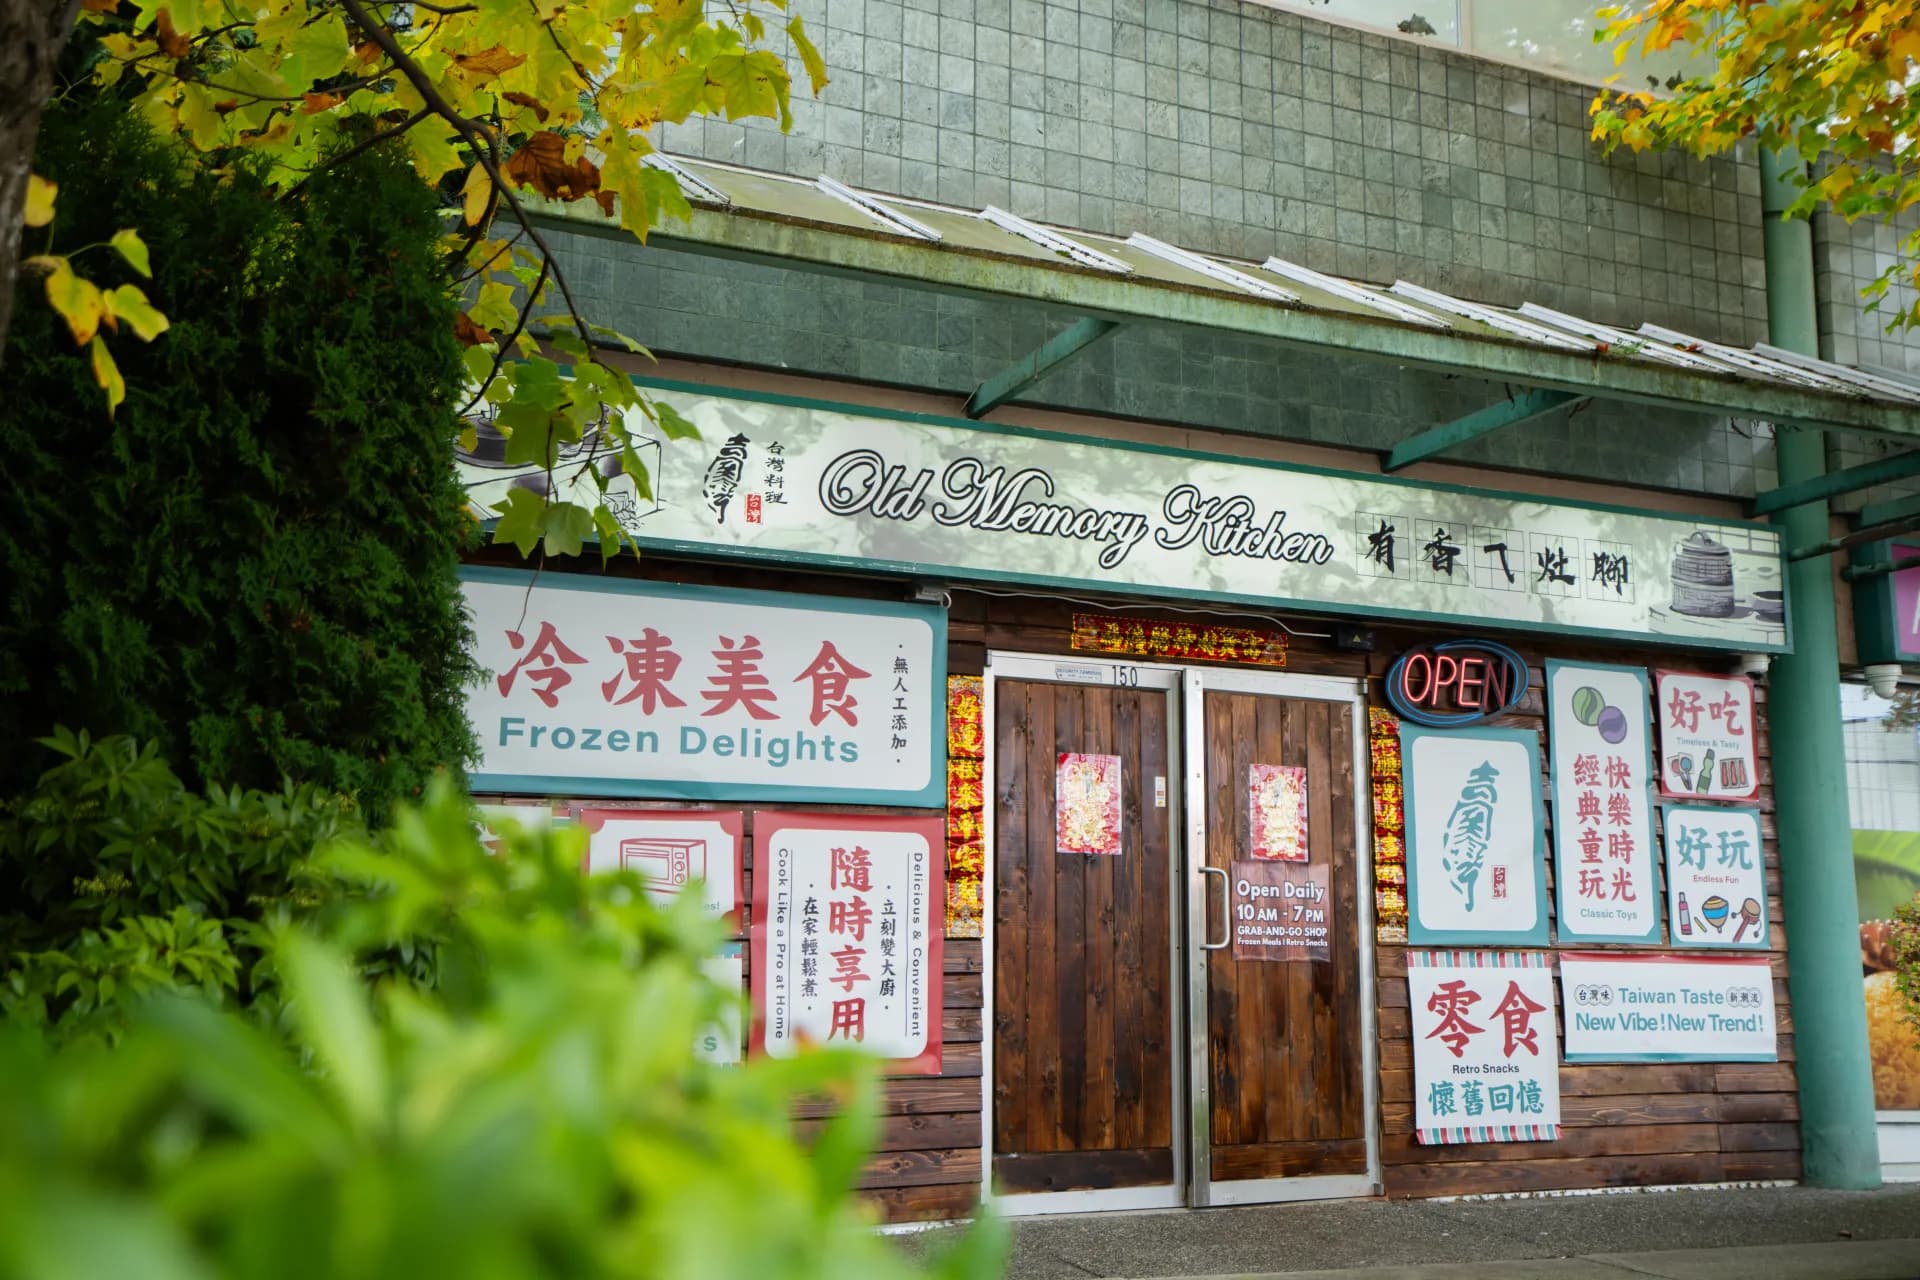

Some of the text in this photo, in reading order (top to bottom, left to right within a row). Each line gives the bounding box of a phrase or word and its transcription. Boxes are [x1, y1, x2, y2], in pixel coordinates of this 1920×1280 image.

[764, 441, 788, 504] 台灣料理
[819, 448, 1334, 569] Old Memory Kitchen
[497, 620, 872, 727] 冷凍美食
[1111, 665, 1138, 687] 150
[1404, 654, 1508, 708] OPEN
[890, 655, 909, 750] 無人工添加
[1668, 687, 1744, 736] 好吃
[500, 717, 859, 767] Frozen Delights
[1573, 754, 1606, 901] 經典童玩
[1605, 755, 1637, 902] 快樂時光
[1675, 824, 1753, 871] 好玩
[1237, 880, 1325, 904] Open Daily
[1693, 874, 1739, 884] Endless Fun
[1237, 926, 1327, 937] GRAB-AND-GO SHOP
[1580, 908, 1637, 920] Classic Toys
[775, 848, 788, 1039] Cook Like a Pro at Home
[801, 897, 819, 998] 在家輕鬆煮
[827, 846, 874, 1043] 隨時享用
[879, 899, 897, 997] 立刻變大廚
[912, 853, 923, 1037] Delicious & Convenient
[1306, 938, 1328, 947] Snacks
[1425, 979, 1547, 1058] 零食
[1618, 987, 1724, 1004] Taiwan Taste
[1575, 1013, 1616, 1031] New
[1668, 1014, 1706, 1032] New
[1708, 1014, 1764, 1032] Trend!
[1452, 1064, 1520, 1074] Retro Snacks
[1428, 1079, 1545, 1117] 懷舊回憶
